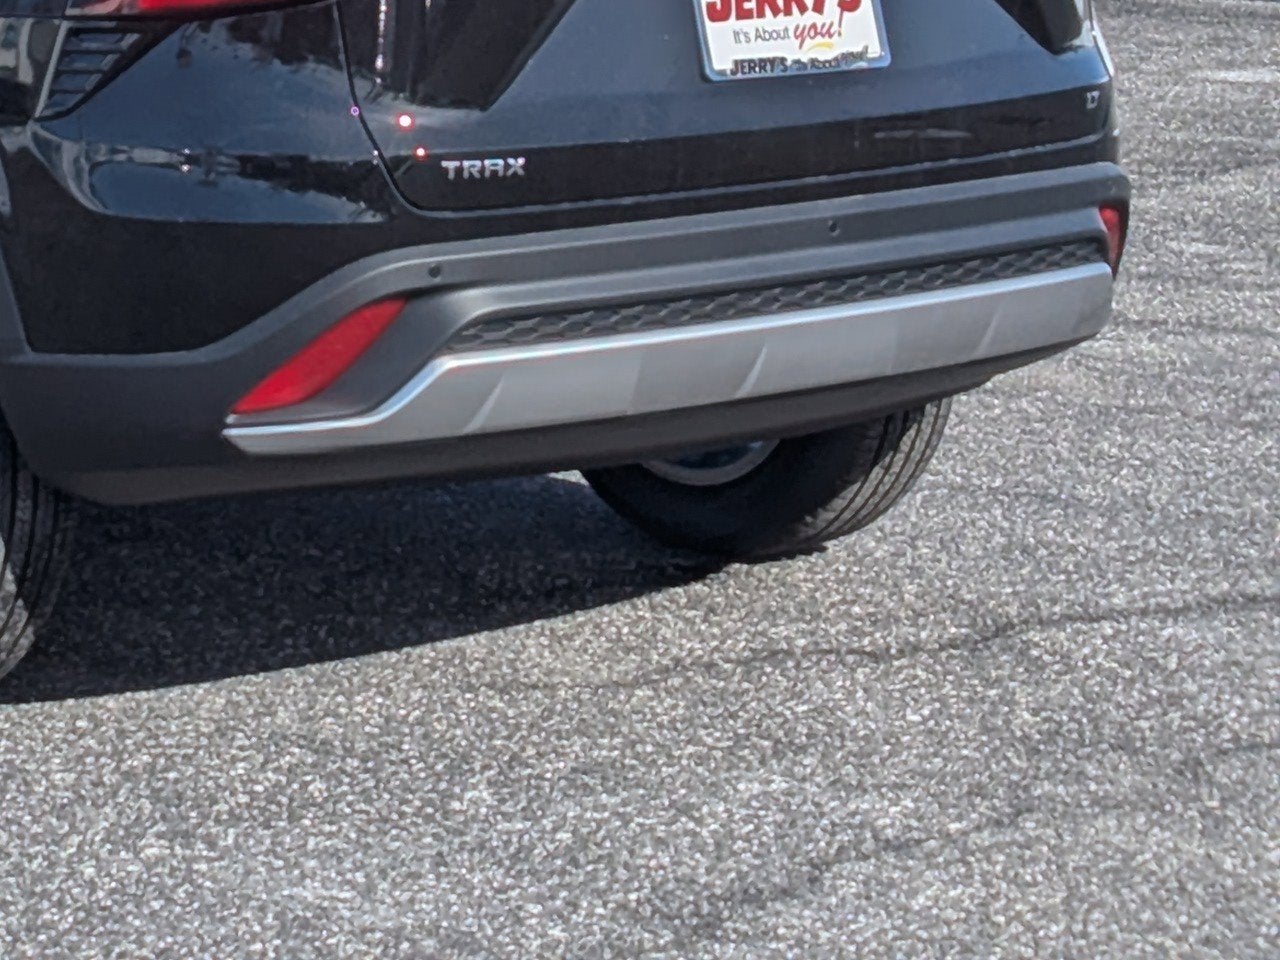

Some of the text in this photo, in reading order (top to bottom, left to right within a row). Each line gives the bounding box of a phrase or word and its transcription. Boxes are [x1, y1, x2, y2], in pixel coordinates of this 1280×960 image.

[733, 11, 843, 50] It's About you!
[730, 56, 788, 76] JERRY'S
[441, 156, 526, 180] TRAX
